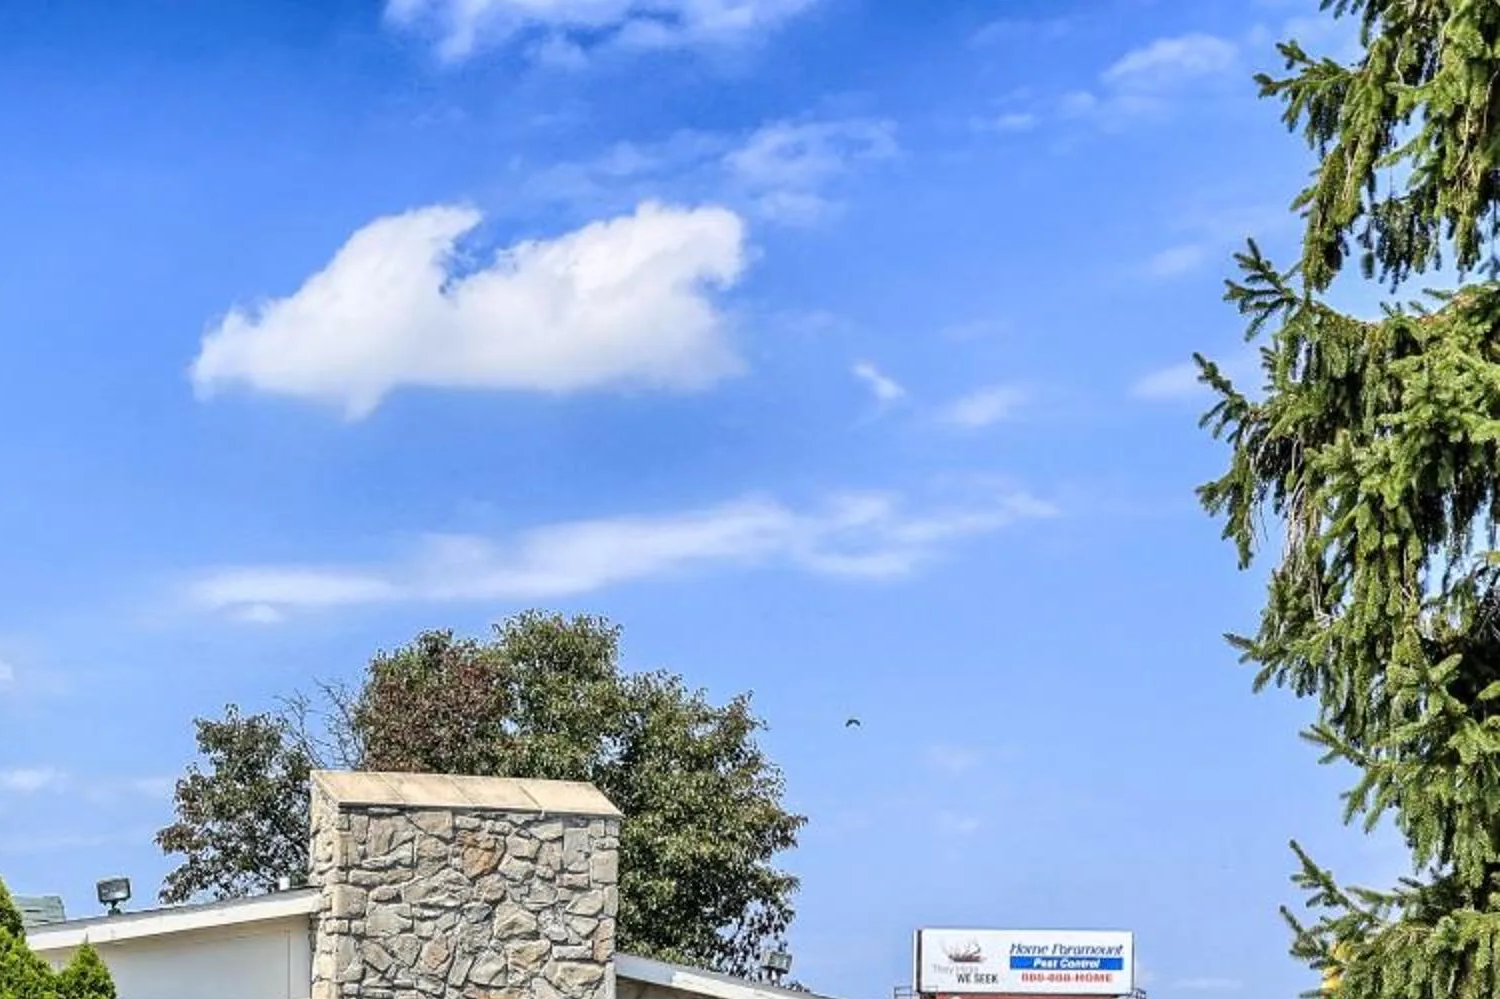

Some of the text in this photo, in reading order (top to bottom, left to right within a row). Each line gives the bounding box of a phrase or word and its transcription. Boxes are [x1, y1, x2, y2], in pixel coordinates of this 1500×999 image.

[1009, 943, 1124, 955] Home Paramount
[1033, 958, 1101, 969] Pest Control
[973, 973, 999, 984] SEEK
